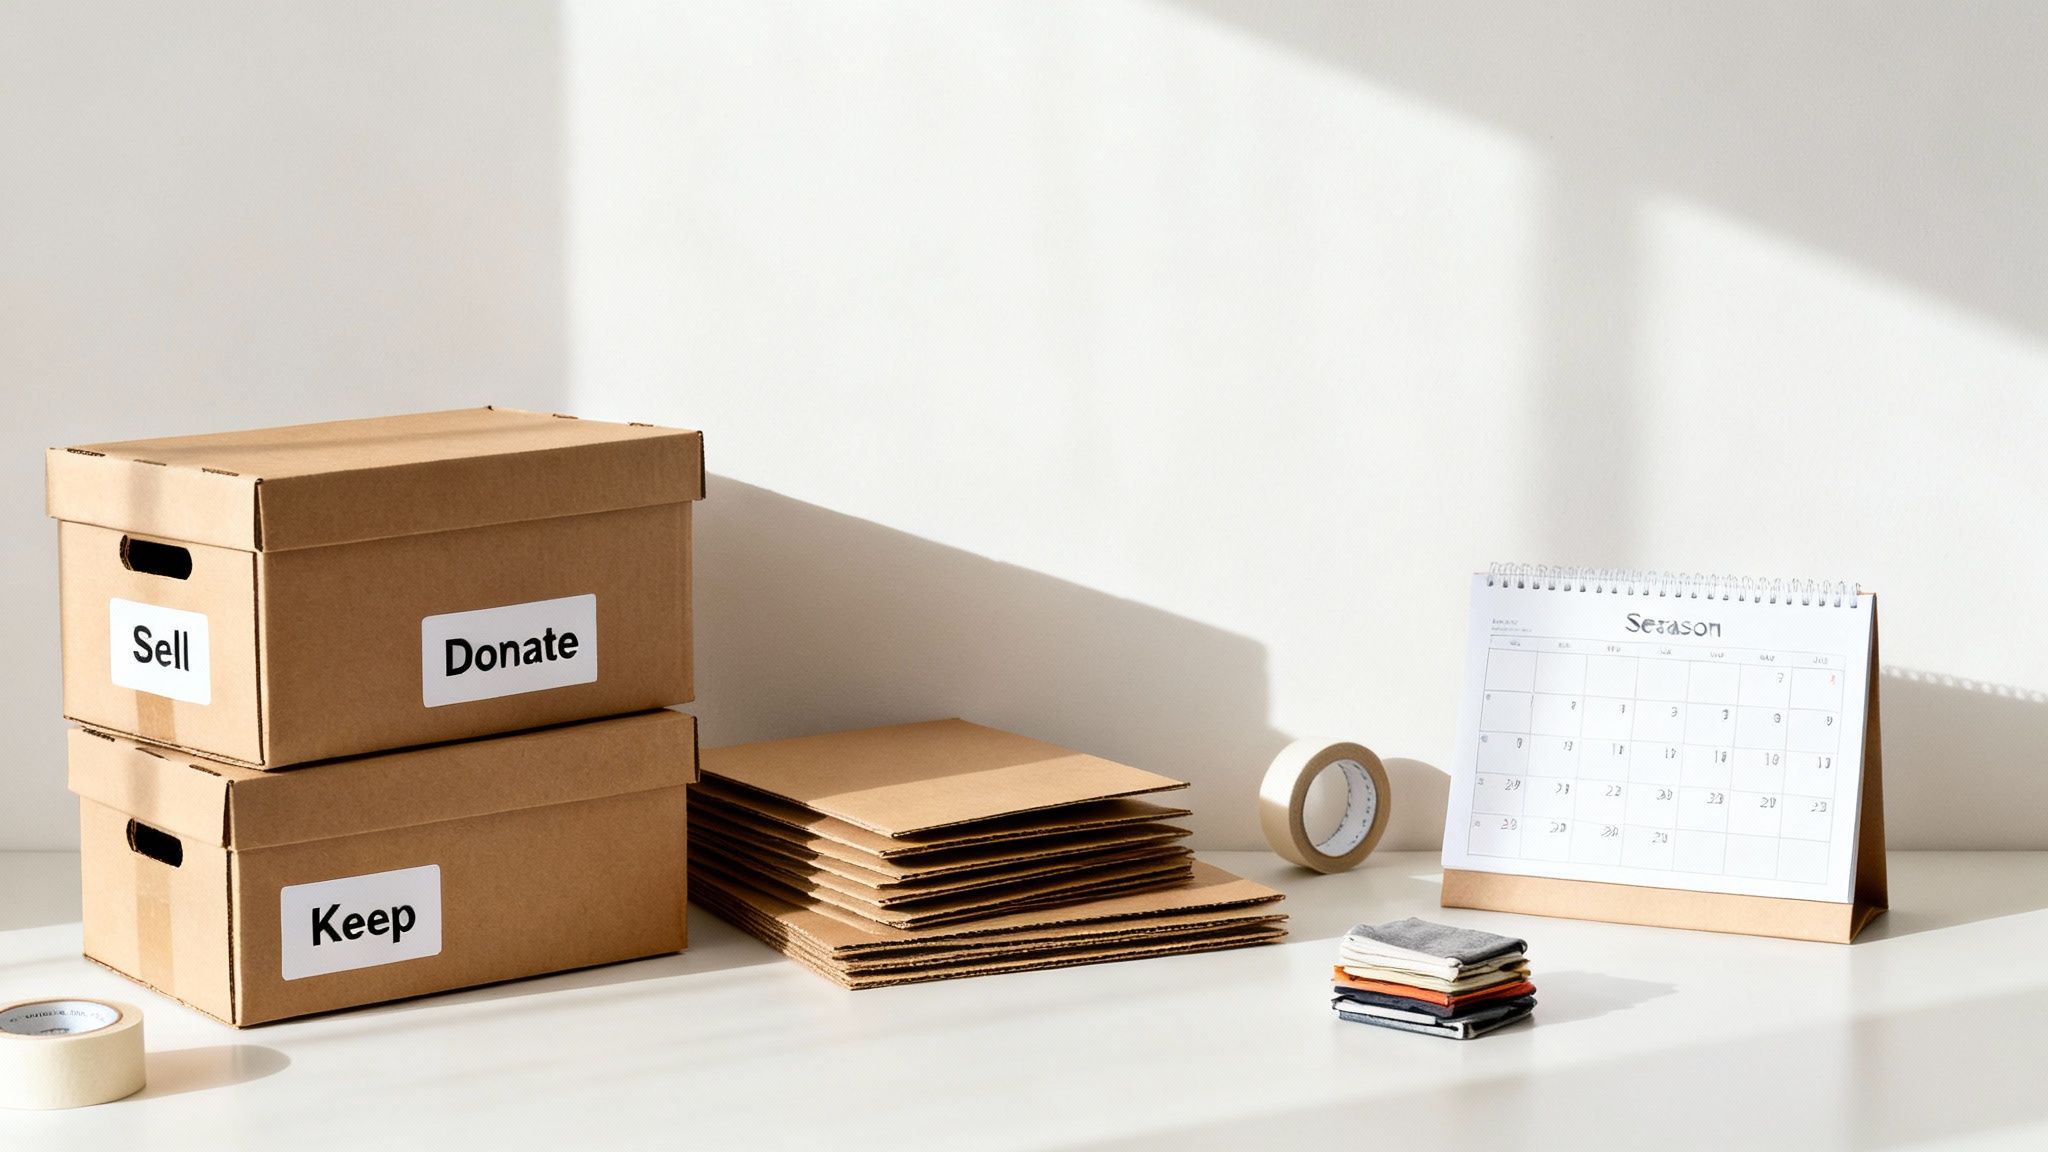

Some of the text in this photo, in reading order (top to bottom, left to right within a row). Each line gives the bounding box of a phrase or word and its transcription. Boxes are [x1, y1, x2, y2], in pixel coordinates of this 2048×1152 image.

[132, 624, 190, 672] Sell
[445, 627, 579, 677] Donate
[311, 903, 416, 947] Keep
